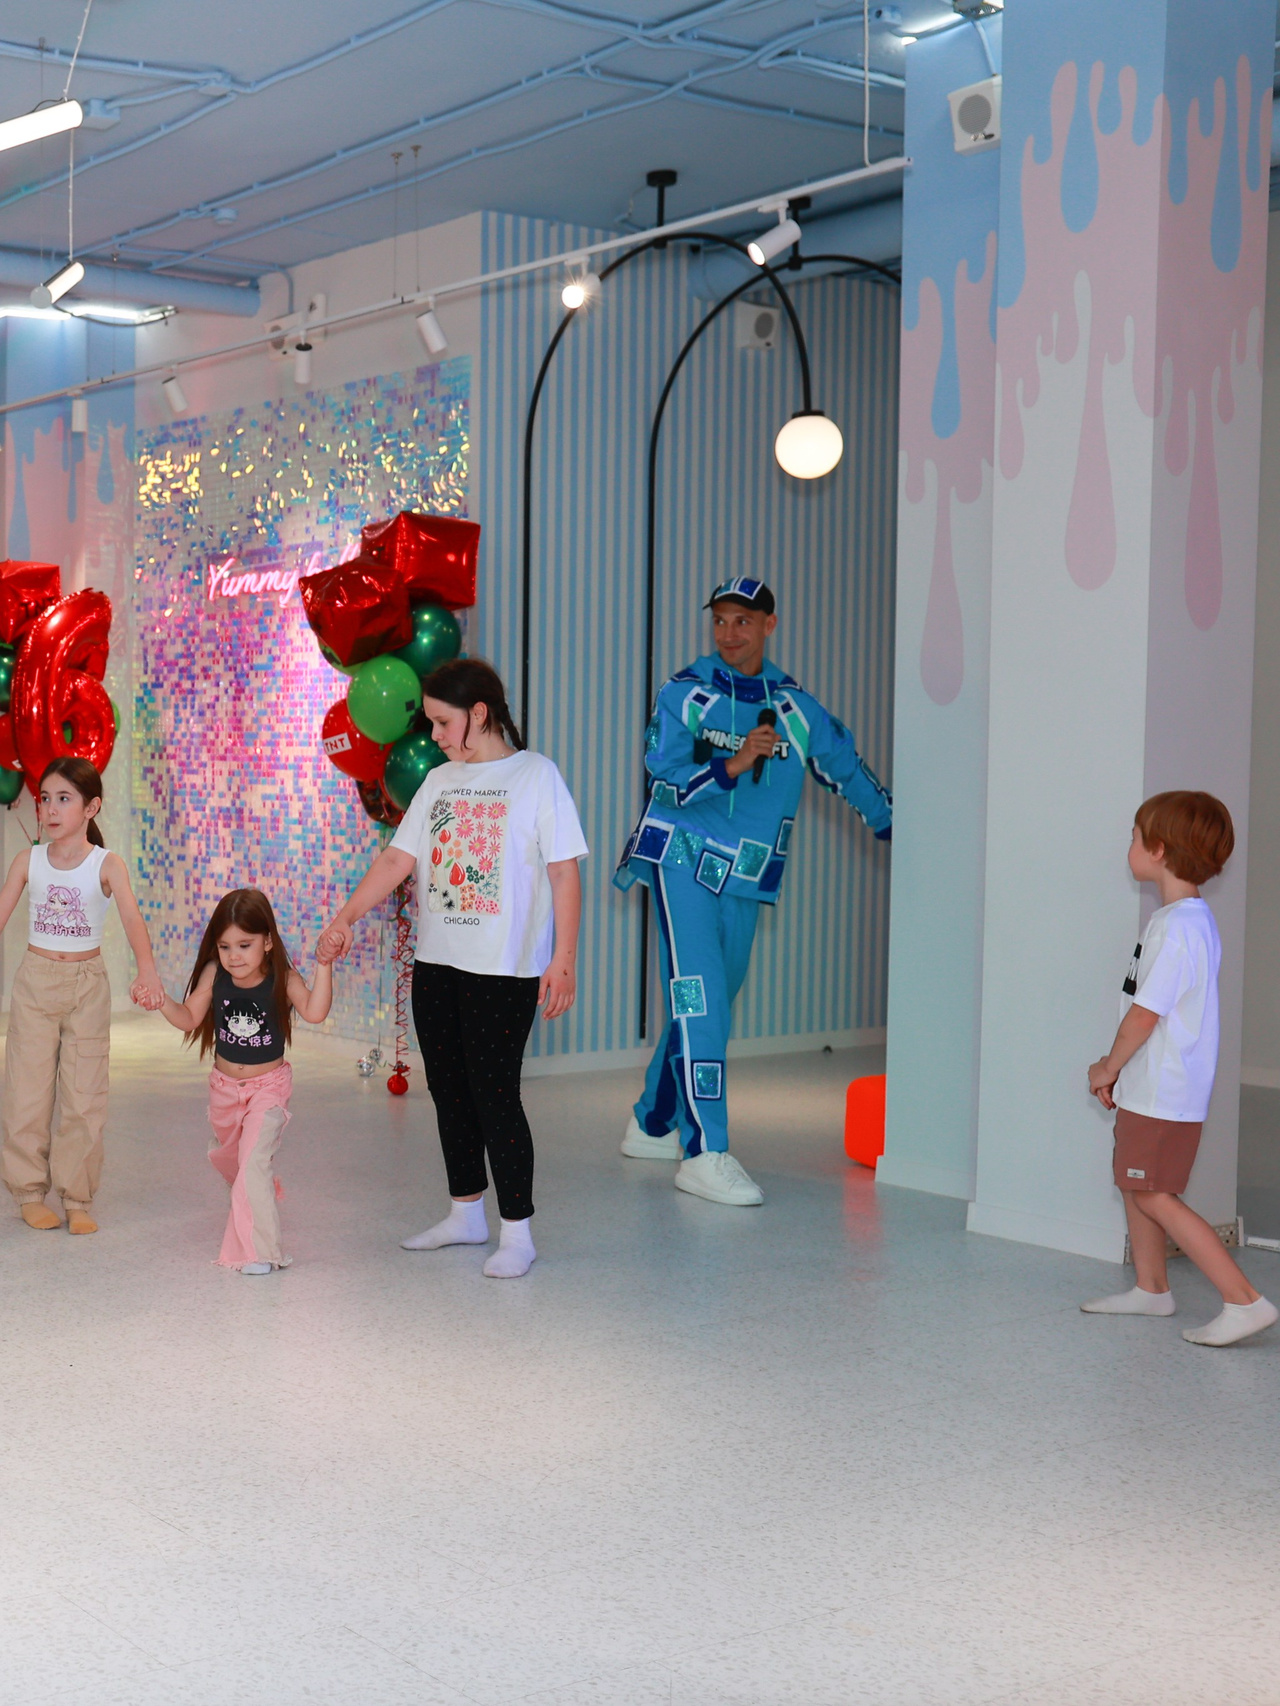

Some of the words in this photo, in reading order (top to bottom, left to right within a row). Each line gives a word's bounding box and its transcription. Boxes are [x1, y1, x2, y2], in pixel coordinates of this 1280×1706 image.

[208, 557, 299, 605] Yummy
[324, 737, 345, 752] TNT
[474, 789, 508, 797] MARKET
[443, 916, 480, 926] CHICAGO
